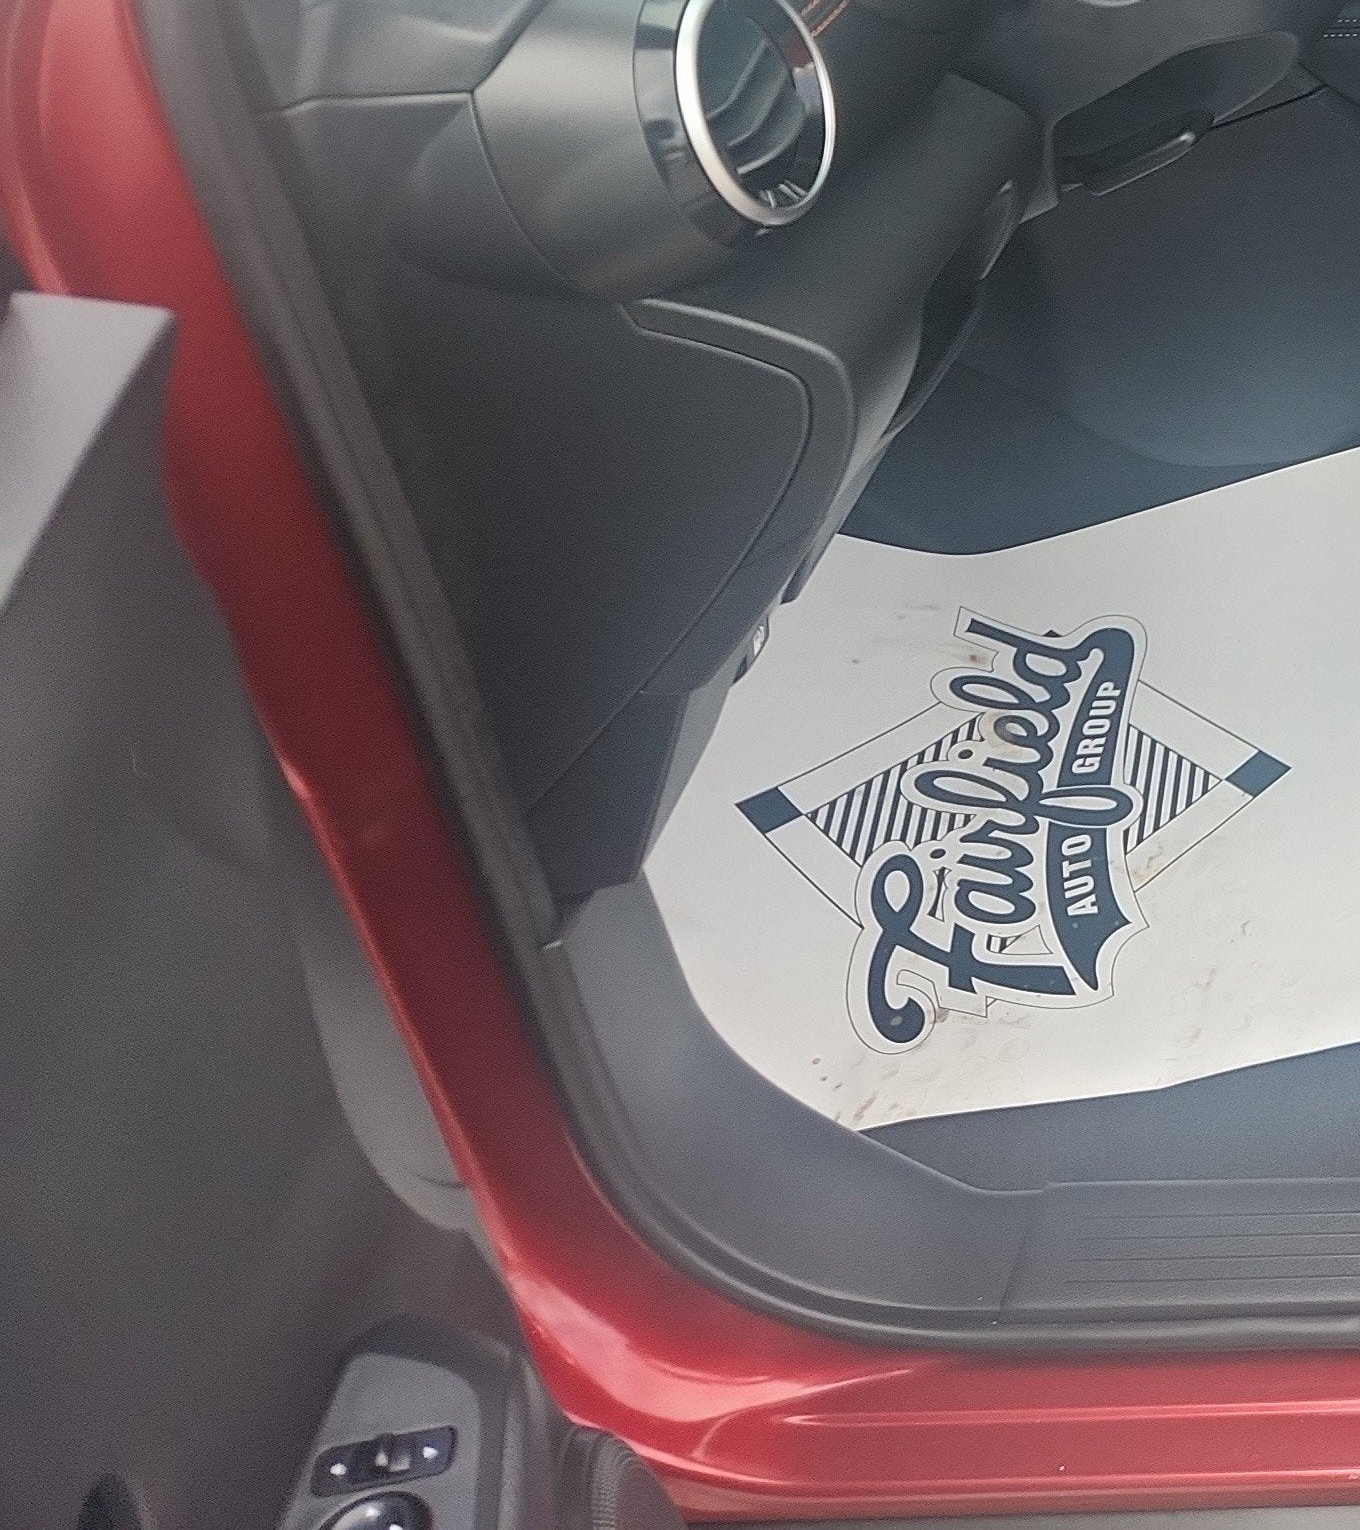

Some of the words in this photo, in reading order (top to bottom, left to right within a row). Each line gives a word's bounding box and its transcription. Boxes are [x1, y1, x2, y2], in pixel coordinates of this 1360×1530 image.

[1072, 681, 1122, 774] GROUP
[867, 617, 1133, 1043] Fairfield
[1065, 834, 1099, 916] AUTO
